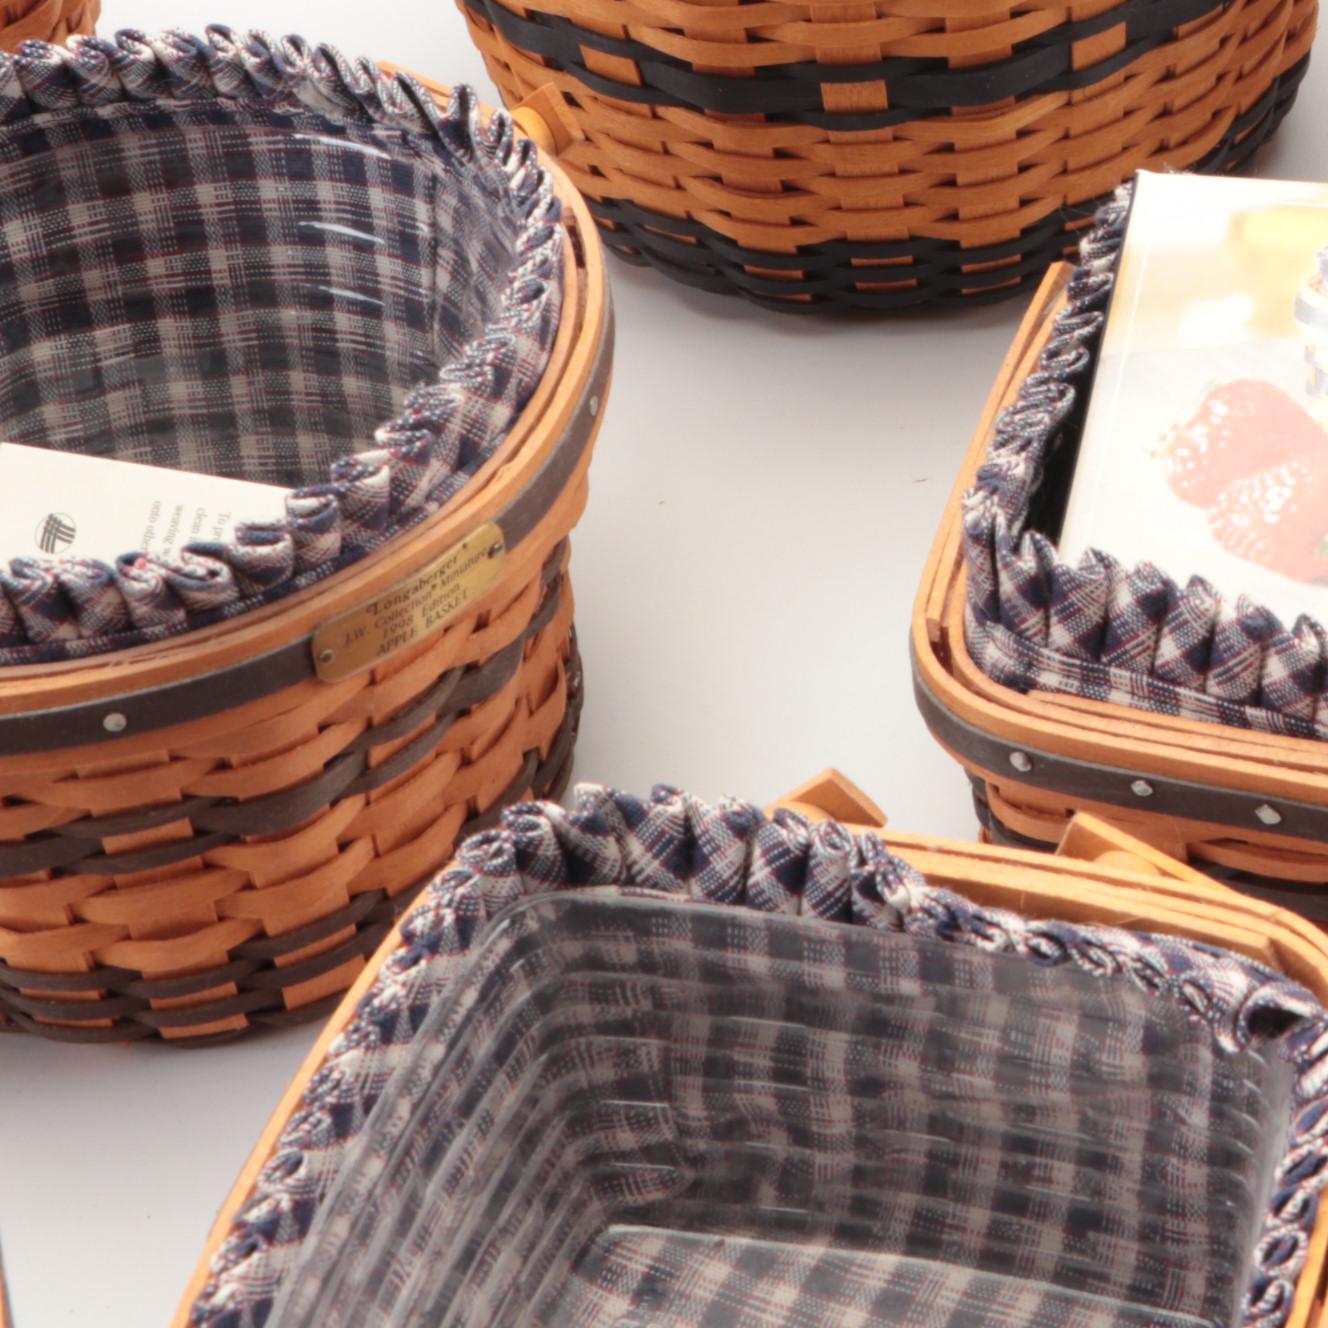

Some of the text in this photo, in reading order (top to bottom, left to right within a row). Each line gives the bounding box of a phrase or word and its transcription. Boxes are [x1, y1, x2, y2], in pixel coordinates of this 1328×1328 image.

[192, 507, 208, 534] clean
[422, 583, 462, 619] Edition
[377, 590, 468, 657] APPLE BASKET
